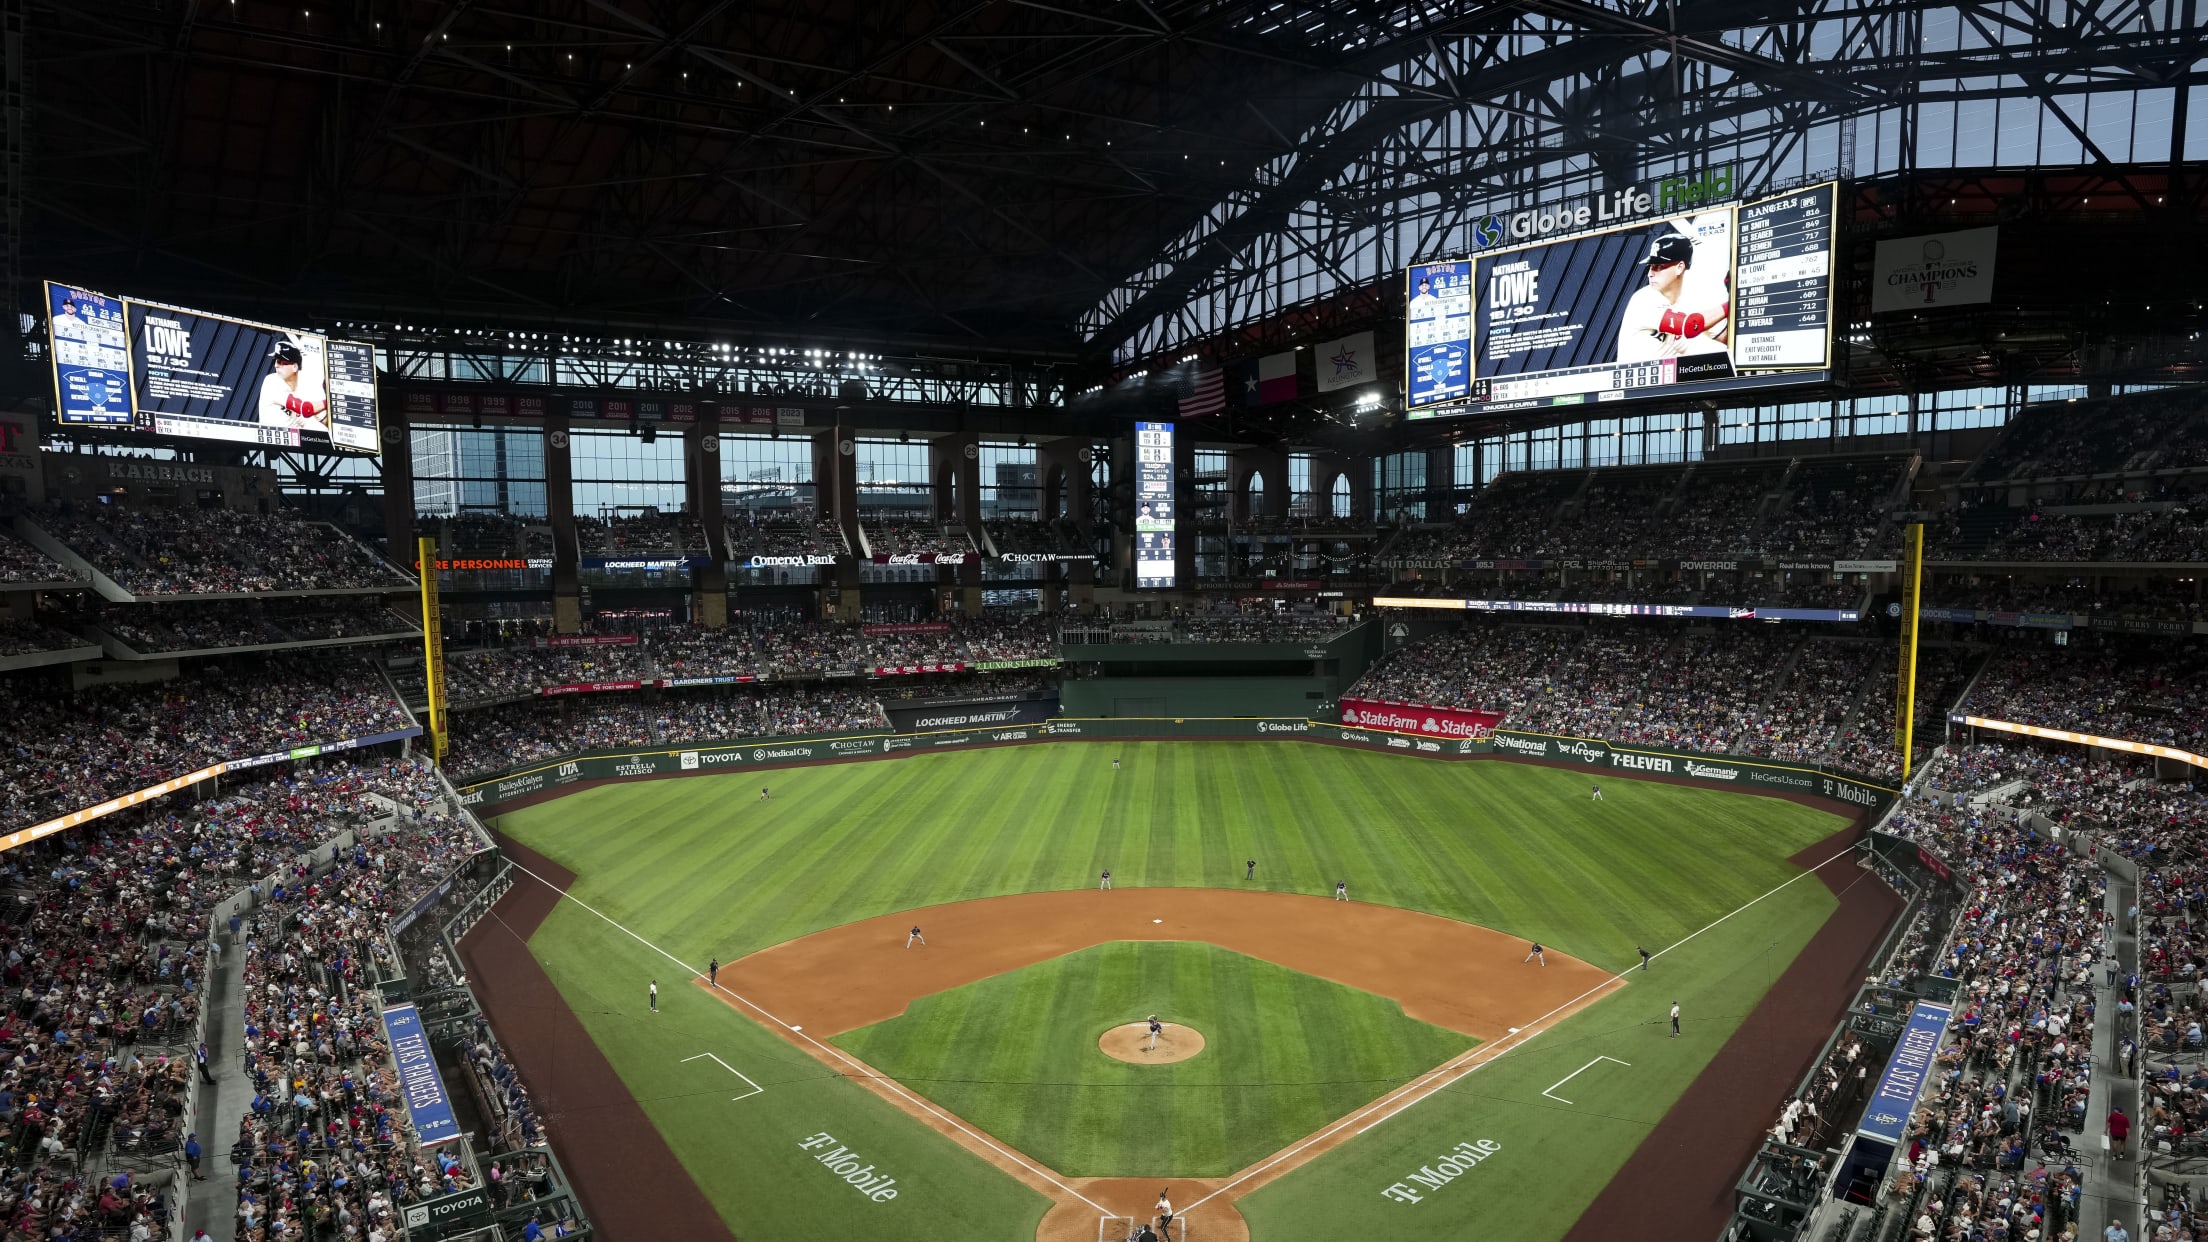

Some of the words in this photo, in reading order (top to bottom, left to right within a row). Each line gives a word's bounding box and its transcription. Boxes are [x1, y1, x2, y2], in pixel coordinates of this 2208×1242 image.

[1511, 203, 1591, 238] Globe
[1599, 187, 1650, 221] Life
[1660, 166, 1732, 209] Field
[1747, 198, 1798, 218] RANGERS
[1751, 219, 1770, 230] SMITH
[1750, 230, 1773, 241] SEAGER
[1750, 240, 1772, 251] SEMIEN
[1802, 232, 1819, 241] .717
[1493, 261, 1530, 276] NATHANIEL
[1749, 264, 1766, 273] LOWE
[1888, 265, 1977, 285] CHAMPIONS
[1435, 277, 1444, 285] 61
[1491, 270, 1539, 308] LOWE
[1920, 280, 1941, 303] T
[70, 290, 105, 306] BOSTON
[1490, 310, 1505, 320] 1B
[1506, 308, 1512, 319] /
[1513, 306, 1534, 316] 30
[1748, 308, 1765, 316] KELLY
[1799, 303, 1816, 311] .712
[145, 316, 182, 329] NATHANIEL
[1748, 318, 1773, 327] TAVERAS
[144, 324, 192, 358] LOWE
[170, 358, 189, 367] 30
[1679, 363, 1728, 374] HeGetsUs.com
[483, 397, 505, 406] 1999
[520, 398, 542, 407] 2010
[573, 401, 593, 409] 2010
[608, 401, 627, 411] 2011
[1483, 402, 1514, 411] KNUCKLE
[641, 403, 659, 412] 2011
[673, 404, 693, 413] 2012
[720, 406, 740, 416] 2015
[752, 408, 770, 416] 2016
[781, 408, 800, 417] 2023
[384, 430, 400, 440] 42
[552, 435, 566, 445] 34
[703, 439, 717, 449] 26
[844, 443, 850, 452] 7
[966, 447, 978, 457] 29
[109, 463, 214, 484] KARBACH
[807, 555, 837, 565] Bank
[889, 554, 919, 564] Coca-Cola
[935, 554, 965, 564] Coca-Cola
[1006, 554, 1056, 562] CHOCTAW
[452, 559, 528, 570] PERSONNEL
[1389, 560, 1403, 568] UT
[1406, 560, 1451, 568] DALLAS
[1563, 561, 1583, 569] PGL
[1680, 561, 1738, 570] POWERADE
[2093, 619, 2117, 627] PERRY
[2124, 620, 2150, 629] PERRY
[2158, 622, 2185, 631] PERRY
[984, 660, 1013, 669] LUXOR
[1014, 659, 1056, 668] STAFFING
[673, 677, 713, 686] GARDENERS
[916, 716, 966, 727] LOCKHEED
[969, 712, 1005, 723] MARTIN
[1360, 711, 1418, 730] StateFarm
[1269, 723, 1292, 732] Globe
[1294, 723, 1308, 731] Life
[1000, 732, 1012, 741] AIR
[1349, 733, 1369, 742] Kubota
[836, 740, 875, 749] CHOCTAW
[1506, 737, 1546, 751] National
[767, 749, 796, 758] Medical
[797, 748, 812, 757] City
[1572, 742, 1605, 763] Kroger
[252, 757, 274, 766] KNUCKLE
[701, 753, 742, 763] TOYOTA
[1611, 753, 1672, 772] 7-ELEVEN
[559, 762, 579, 776] UTA
[616, 763, 656, 772] ESTRELLA
[620, 768, 653, 776] JALISCO
[1700, 765, 1738, 777] Germania
[499, 775, 543, 792] Bailey&Galyen
[1751, 772, 1813, 787] HeGetsUs.com
[500, 788, 525, 799] ATTORNEYS
[1824, 779, 1833, 795] T
[1837, 783, 1877, 806] Mobile
[391, 911, 416, 937] Germania
[395, 1033, 427, 1065] TEXAS
[1881, 1067, 1922, 1101] TEXAS
[1902, 1027, 1937, 1069] RANGERS
[403, 1062, 442, 1110] RANGERS
[1406, 1139, 1501, 1191] Mobile
[814, 1145, 898, 1203] Mobile
[433, 1196, 483, 1217] TOYOTA
